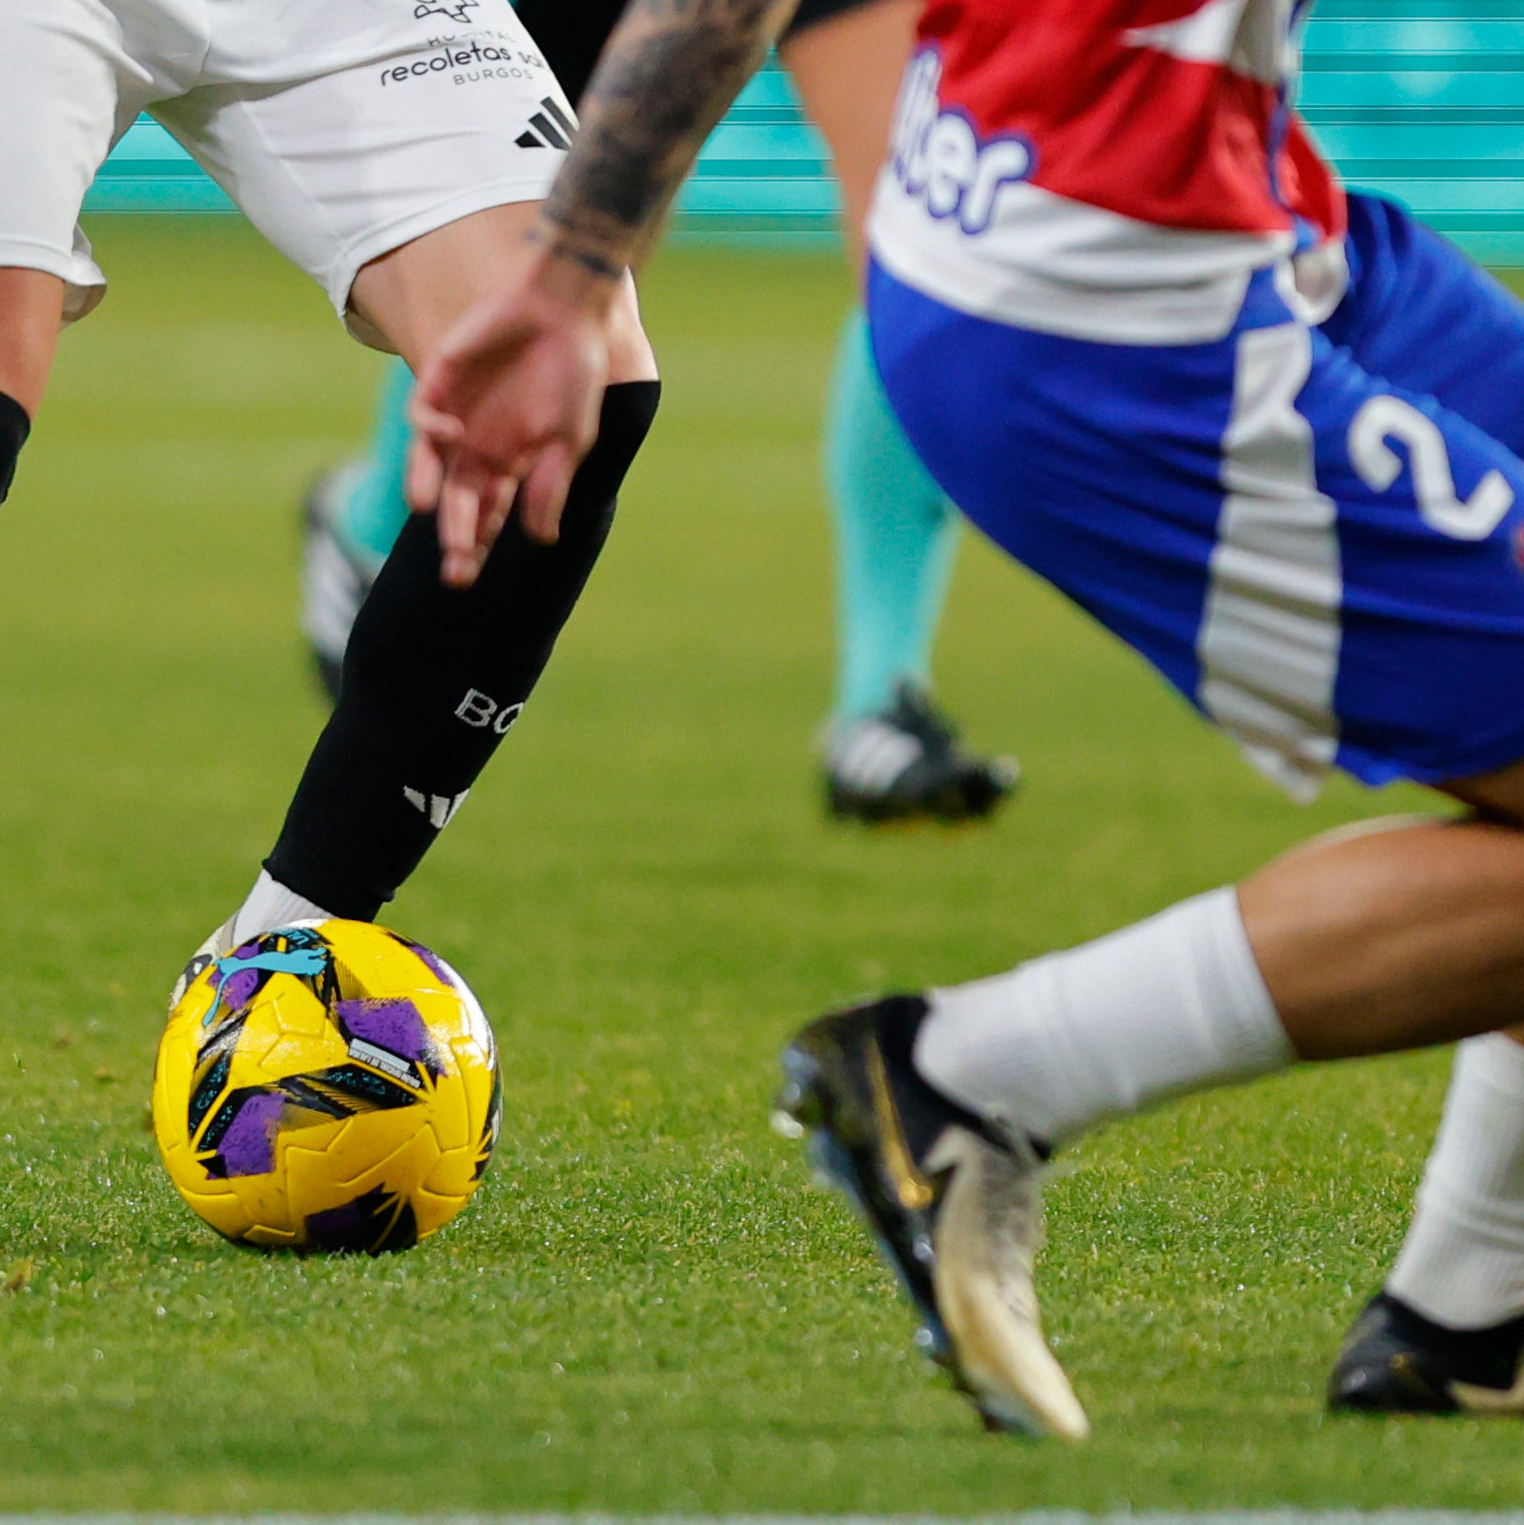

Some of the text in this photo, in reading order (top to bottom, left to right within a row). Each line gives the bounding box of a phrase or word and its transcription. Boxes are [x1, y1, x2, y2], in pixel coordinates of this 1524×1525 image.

[380, 41, 512, 87] recoletas
[453, 66, 534, 86] BURGOS
[1348, 395, 1515, 542] 2
